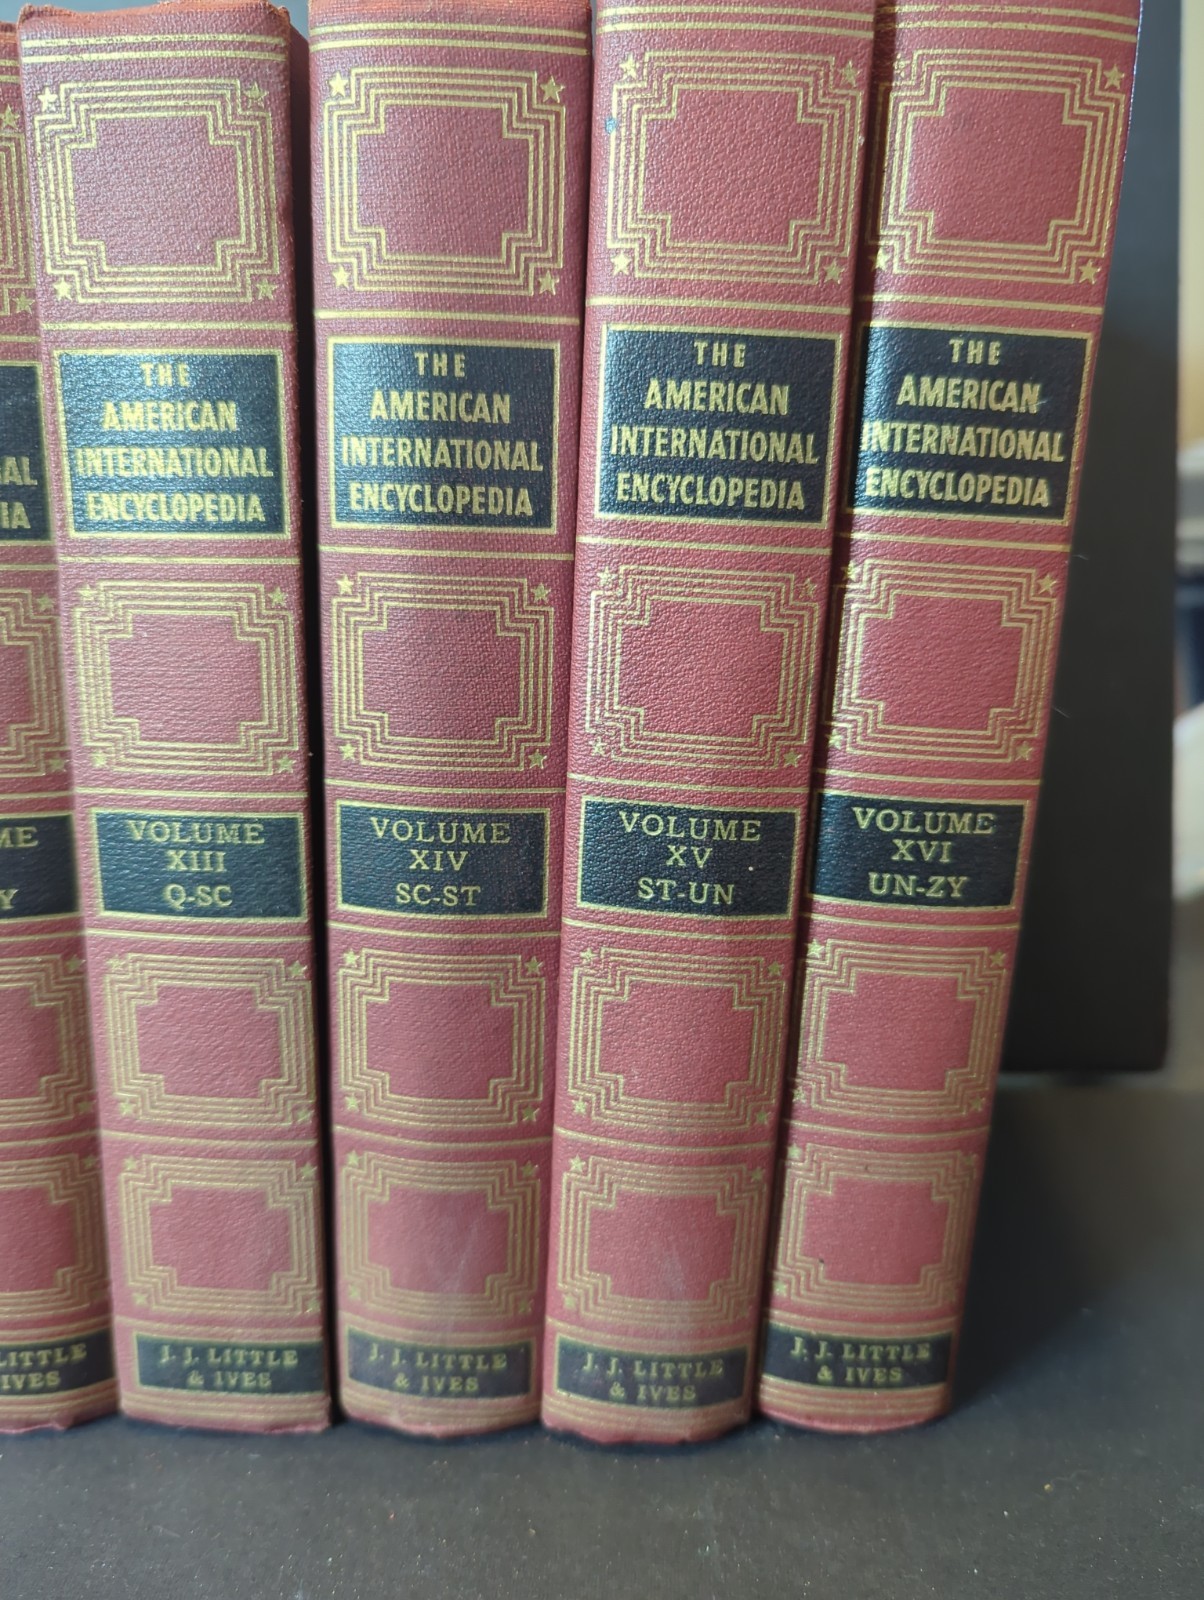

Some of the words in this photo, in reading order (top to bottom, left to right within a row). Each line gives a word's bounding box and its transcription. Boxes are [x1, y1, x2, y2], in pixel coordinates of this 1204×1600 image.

[414, 352, 466, 378] THE
[693, 340, 747, 368] THE
[949, 338, 1001, 366] THE
[140, 362, 191, 387] THE
[370, 389, 511, 424] AMERICAN
[643, 378, 790, 416] AMERICAN
[896, 374, 1041, 414] AMERICAN
[102, 400, 237, 432] AMERICAN
[340, 435, 544, 472] INTERNATIONAL
[610, 424, 818, 465] INTERNATIONAL
[861, 419, 1065, 463] INTERNATIONAL
[76, 447, 274, 478] INTERNATIONAL
[350, 482, 533, 516] ENCYCLOPEDIA
[616, 471, 805, 511] ENCYCLOPEDIA
[864, 466, 1049, 508] ENCYCLOPEDIA
[87, 492, 266, 522] ENCYCLOPEDIA
[127, 820, 265, 844] VOLUME
[370, 817, 511, 844] VOLUME
[618, 811, 762, 842] VOLUME
[852, 806, 998, 835] VOLUME
[166, 850, 227, 873] XIII
[409, 849, 469, 871] XIV
[665, 844, 713, 869] XV
[891, 839, 955, 863] XVI
[163, 883, 233, 910] Q-SC
[395, 883, 481, 907] SC-ST
[637, 876, 735, 905] ST-UN
[868, 871, 970, 898] UN-ZY
[208, 1347, 299, 1367] LITTLE
[415, 1351, 507, 1370] LITTLE
[842, 1342, 931, 1361] LITTLE
[1, 1371, 60, 1389] IVES
[187, 1370, 205, 1387] &
[214, 1371, 272, 1388] IVES
[633, 1359, 724, 1378] LITTLE
[817, 1365, 833, 1382] &
[845, 1367, 903, 1382] IVES
[394, 1373, 410, 1389] &
[420, 1375, 479, 1392] IVES
[609, 1381, 626, 1398] &
[637, 1384, 697, 1401] IVES
